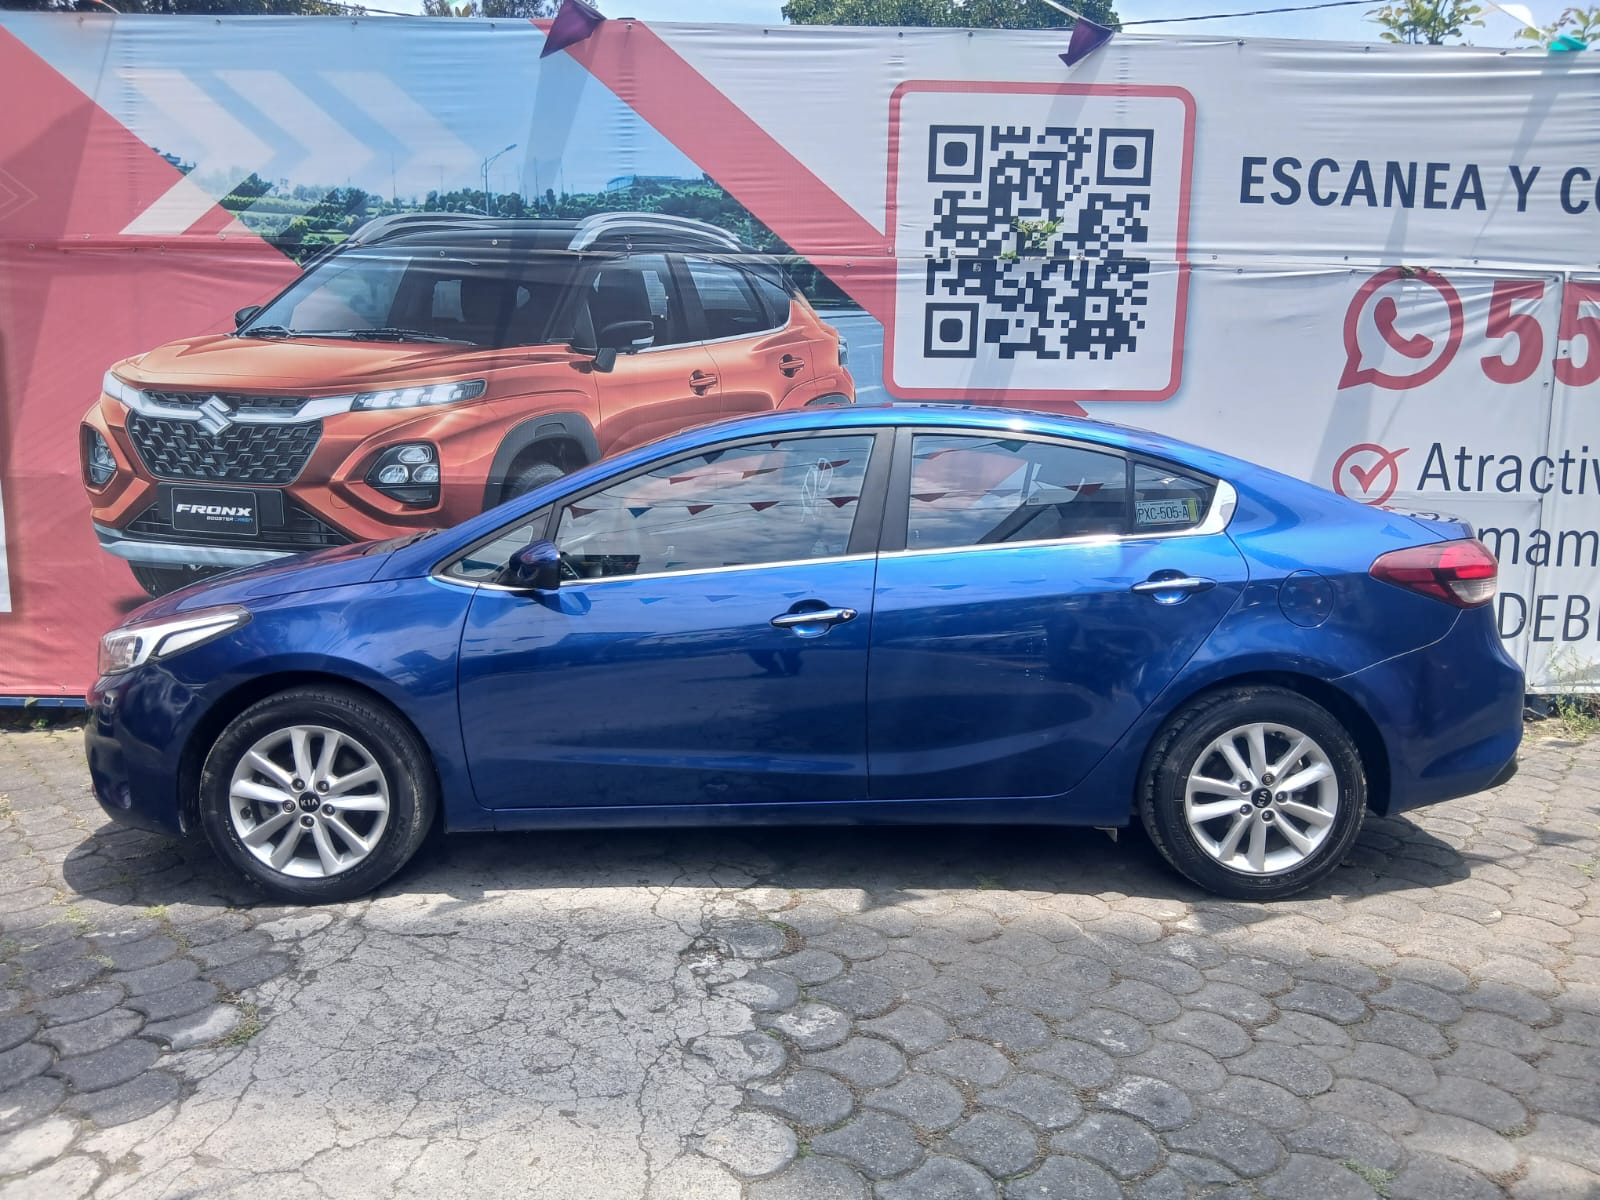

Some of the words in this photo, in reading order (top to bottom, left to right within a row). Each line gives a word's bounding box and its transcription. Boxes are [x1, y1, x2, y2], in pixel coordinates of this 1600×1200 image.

[1239, 156, 1487, 211] ESCANEA
[1508, 165, 1541, 212] Y
[1560, 167, 1600, 215] C
[1480, 280, 1600, 387] 55
[176, 503, 252, 517] FRONX
[1137, 505, 1189, 521] PXC-505-A
[1497, 592, 1600, 642] DEB
[300, 798, 319, 807] KIA
[1256, 790, 1268, 807] KIA
